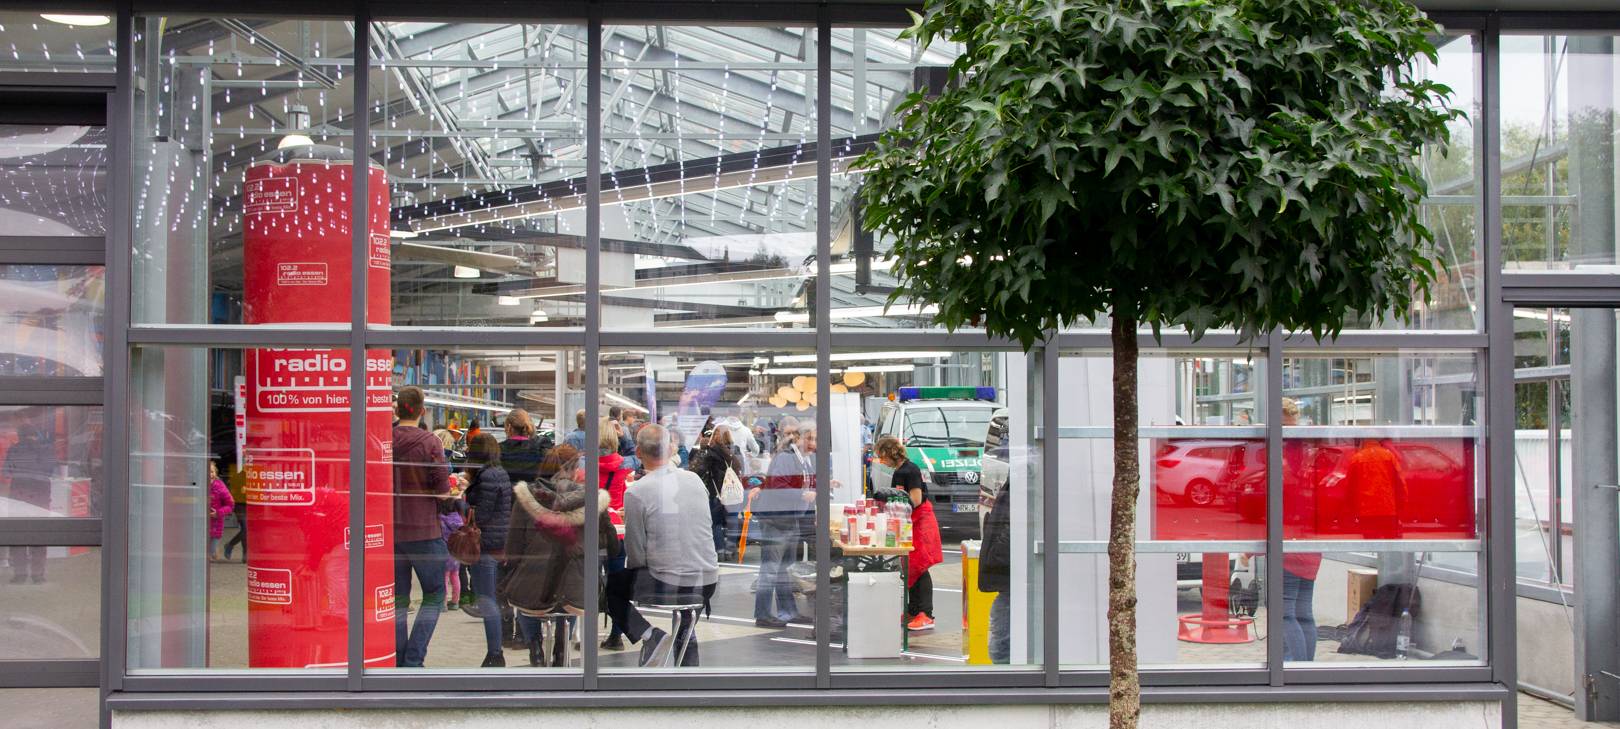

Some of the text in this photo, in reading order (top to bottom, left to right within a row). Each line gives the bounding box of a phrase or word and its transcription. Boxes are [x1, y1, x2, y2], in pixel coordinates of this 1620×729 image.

[274, 354, 347, 372] radio
[302, 396, 323, 405] von
[326, 394, 350, 405] hier.
[259, 471, 305, 480] essen
[270, 493, 289, 501] beste
[290, 493, 305, 501] Mix.
